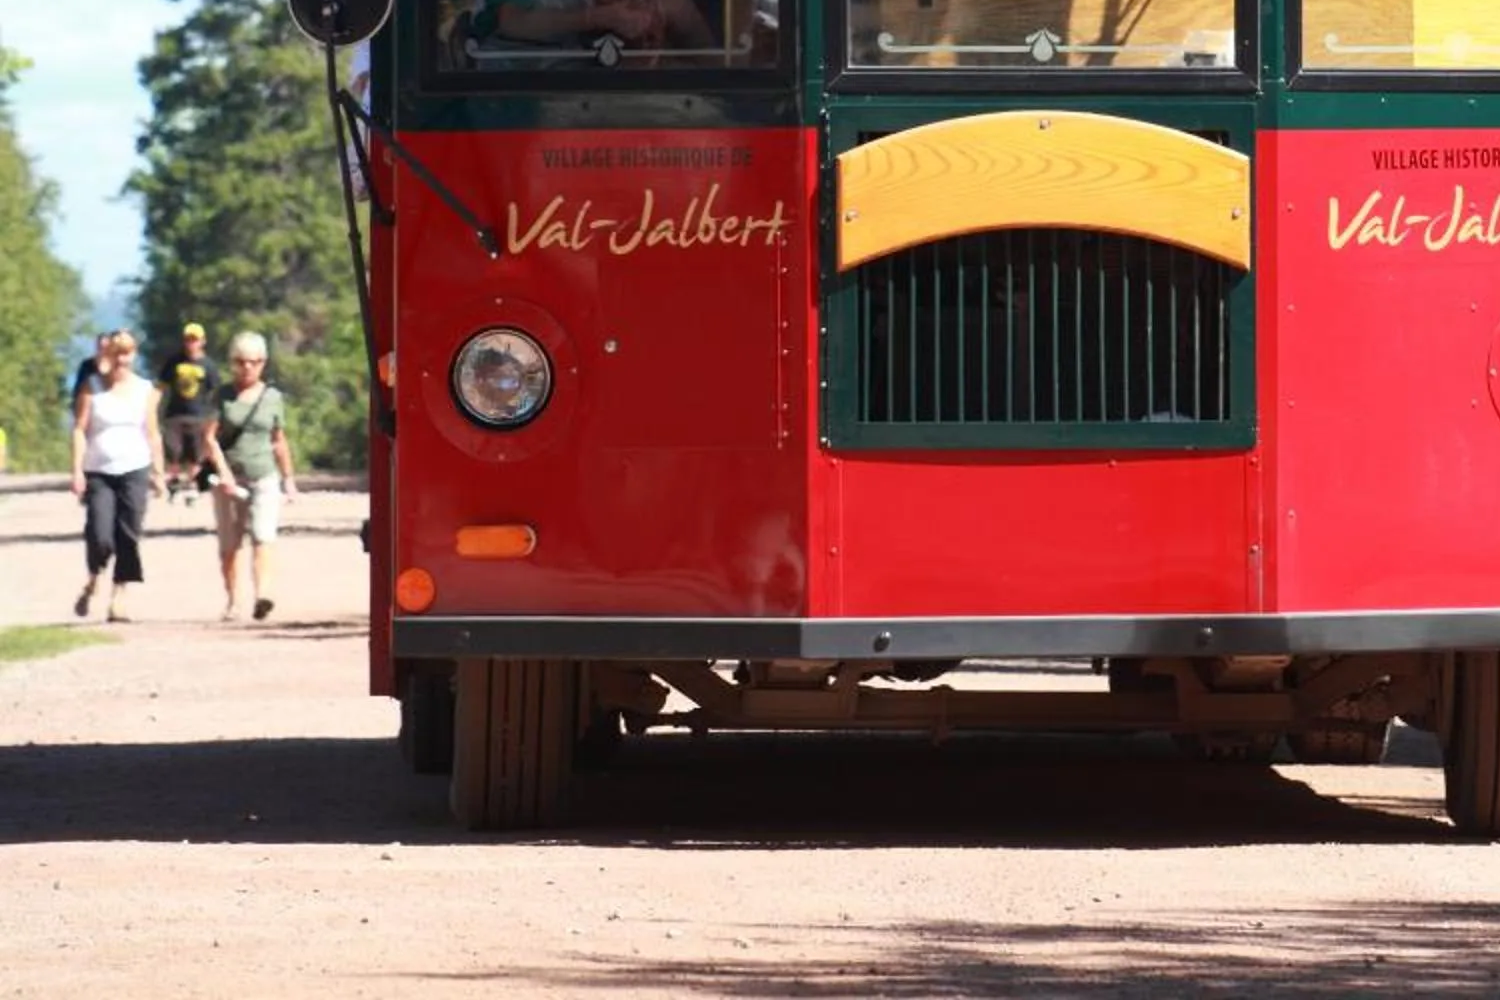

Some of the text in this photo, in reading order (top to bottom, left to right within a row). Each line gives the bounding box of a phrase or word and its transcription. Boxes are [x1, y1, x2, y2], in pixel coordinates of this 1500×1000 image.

[542, 146, 753, 169] VILLAGE HISTORIQUE DE
[1372, 150, 1439, 170] VILLAGE
[508, 183, 796, 255] Val-Jalbert
